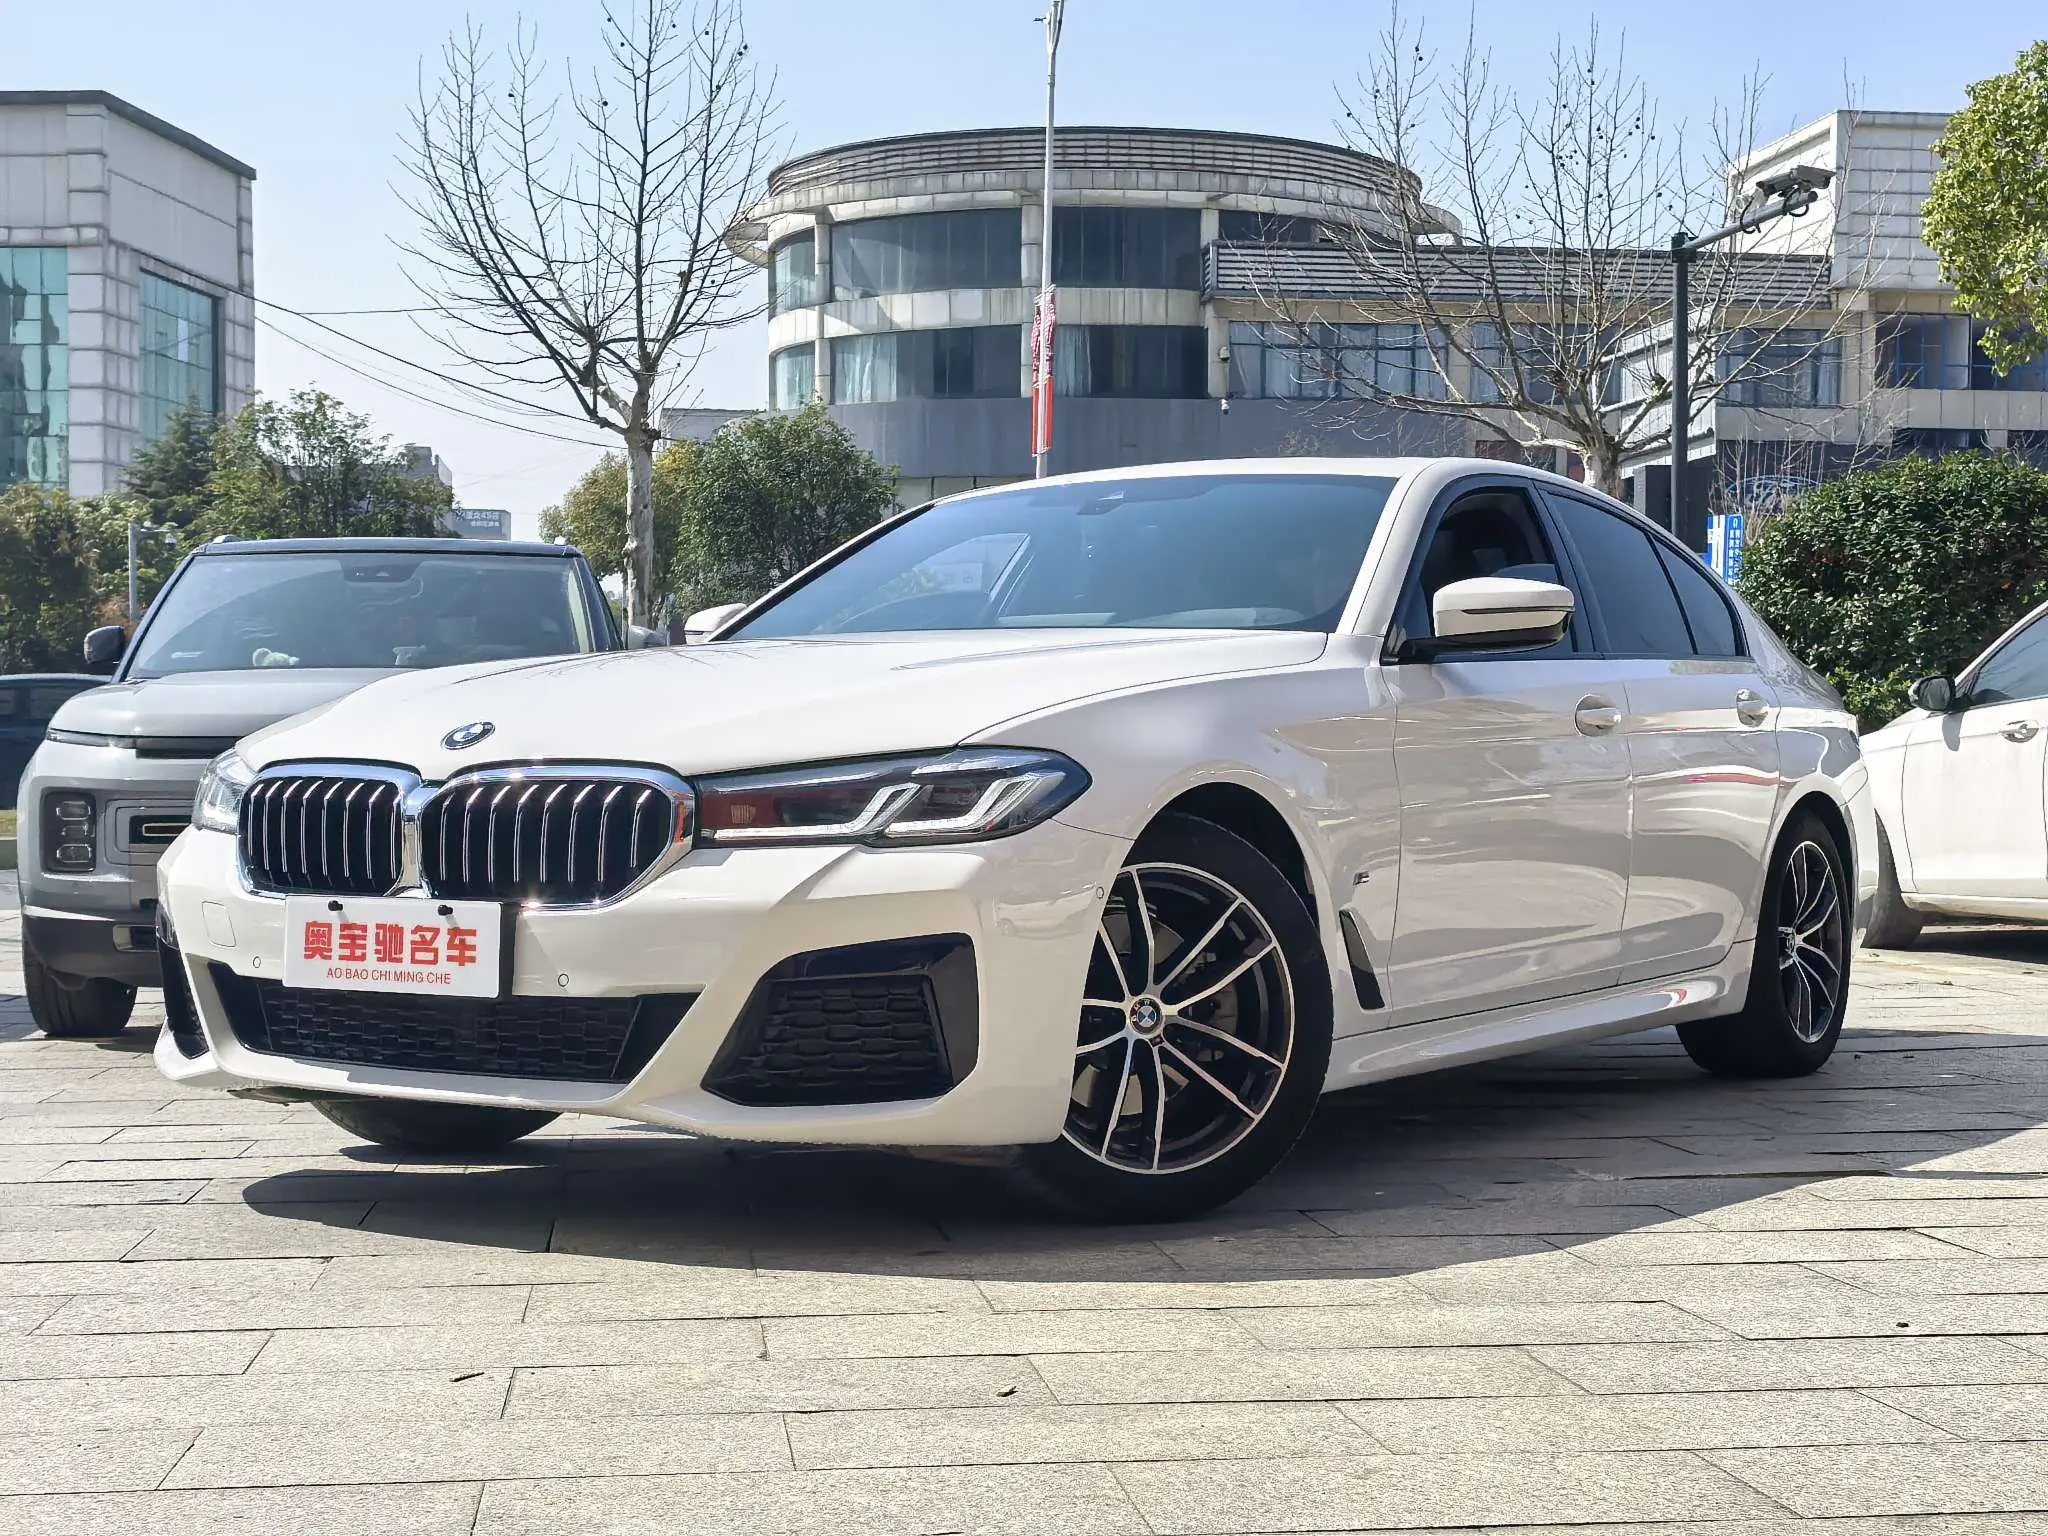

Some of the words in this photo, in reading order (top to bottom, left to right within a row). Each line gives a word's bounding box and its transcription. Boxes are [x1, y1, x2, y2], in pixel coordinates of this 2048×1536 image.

[304, 921, 476, 966] 奥宝驰名车
[326, 968, 344, 979] AO
[345, 968, 368, 980] BAO
[371, 968, 391, 981] CHI
[393, 970, 424, 983] MING
[427, 972, 451, 984] CHE
